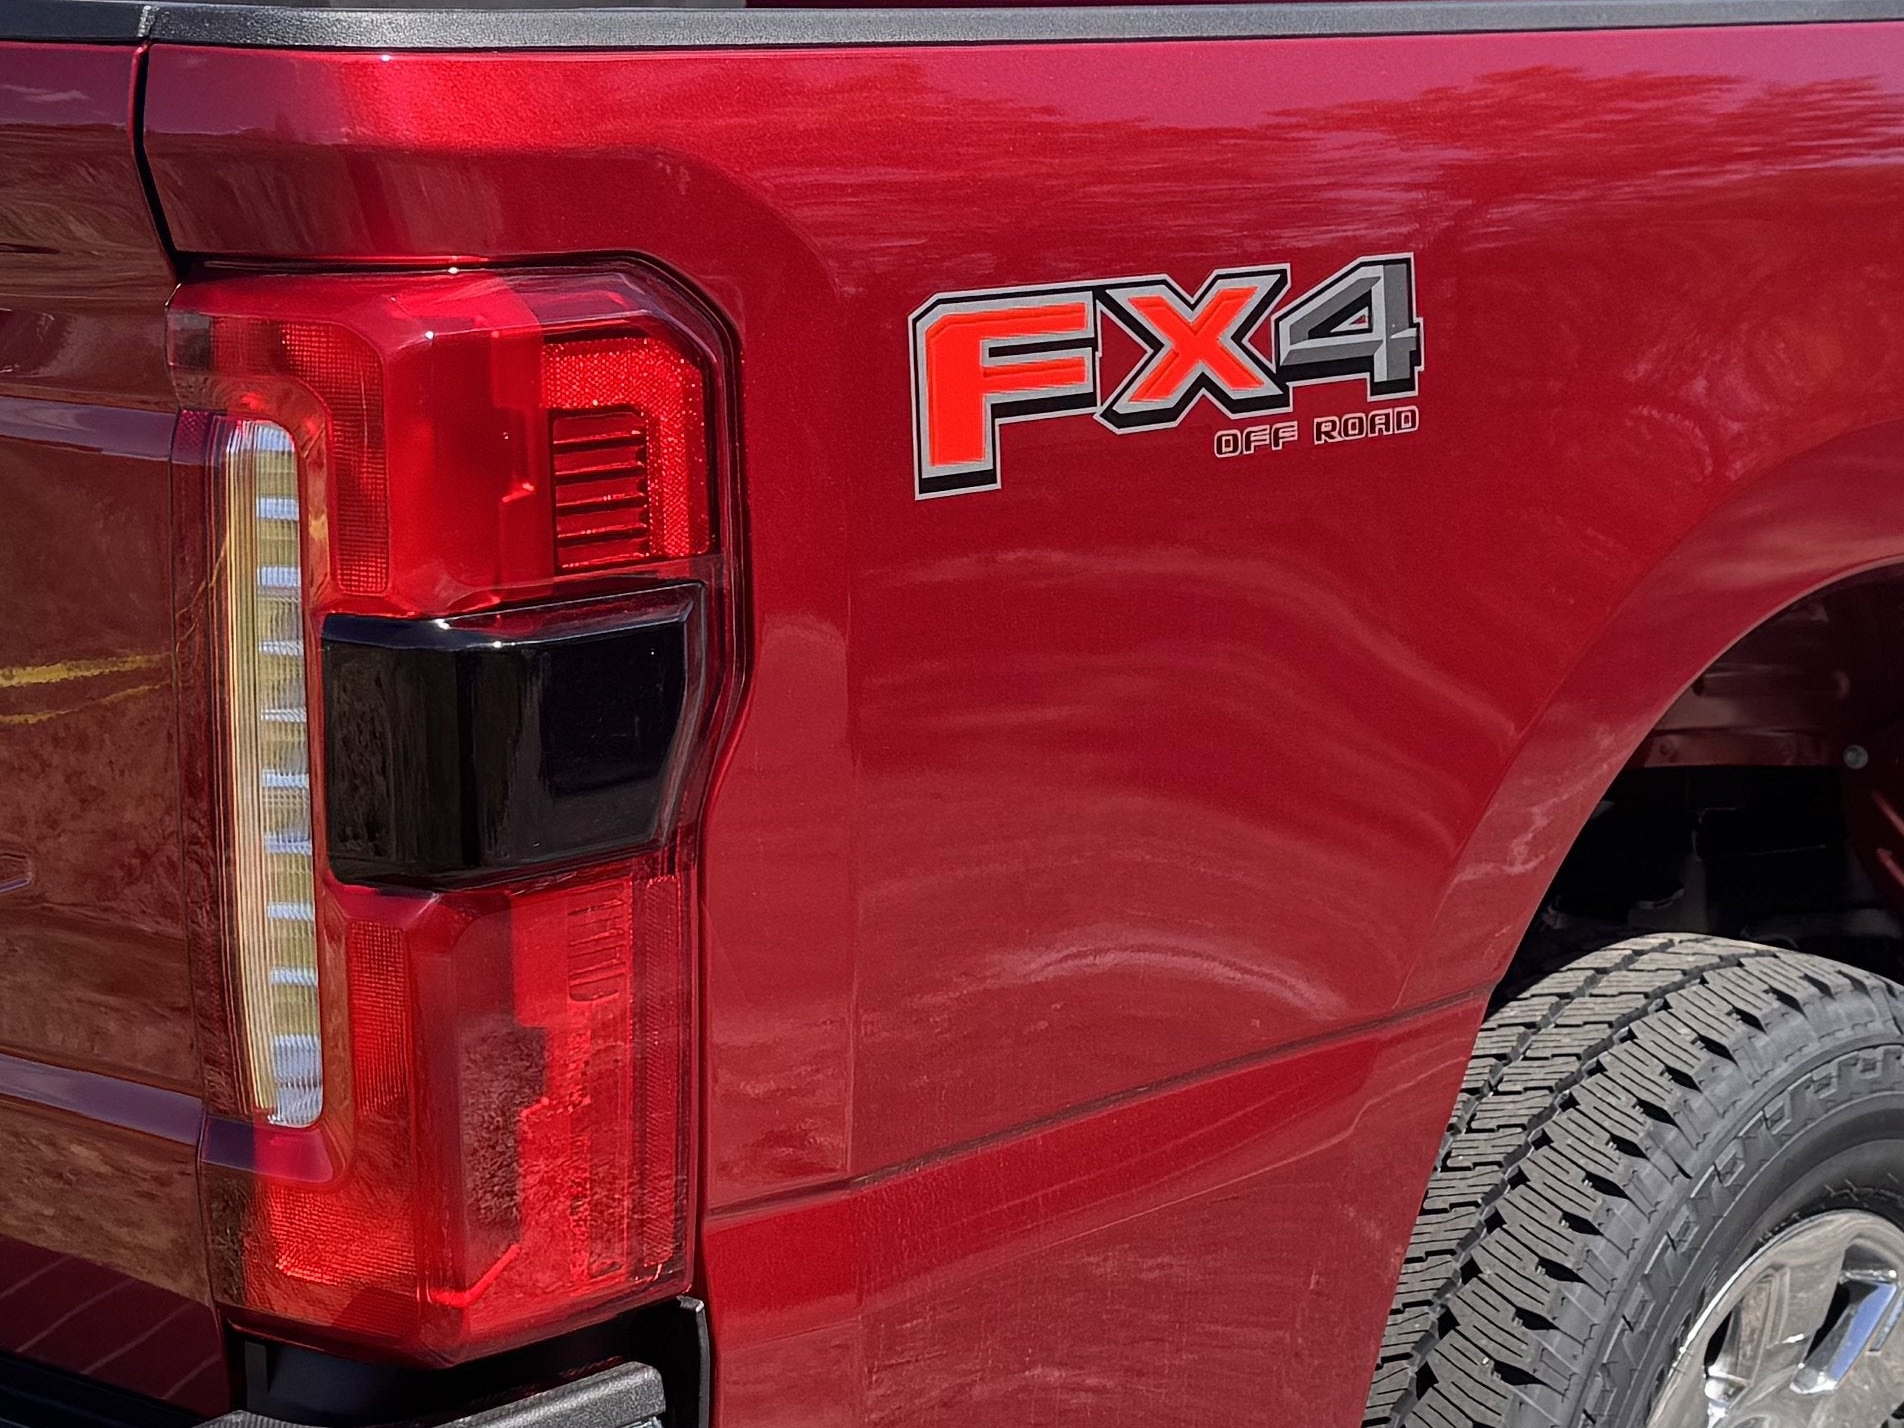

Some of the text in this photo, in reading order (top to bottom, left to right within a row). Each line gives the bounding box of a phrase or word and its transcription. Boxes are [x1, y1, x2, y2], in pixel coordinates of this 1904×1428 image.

[907, 252, 1425, 501] FX4
[1213, 404, 1420, 459] OFF ROAD
